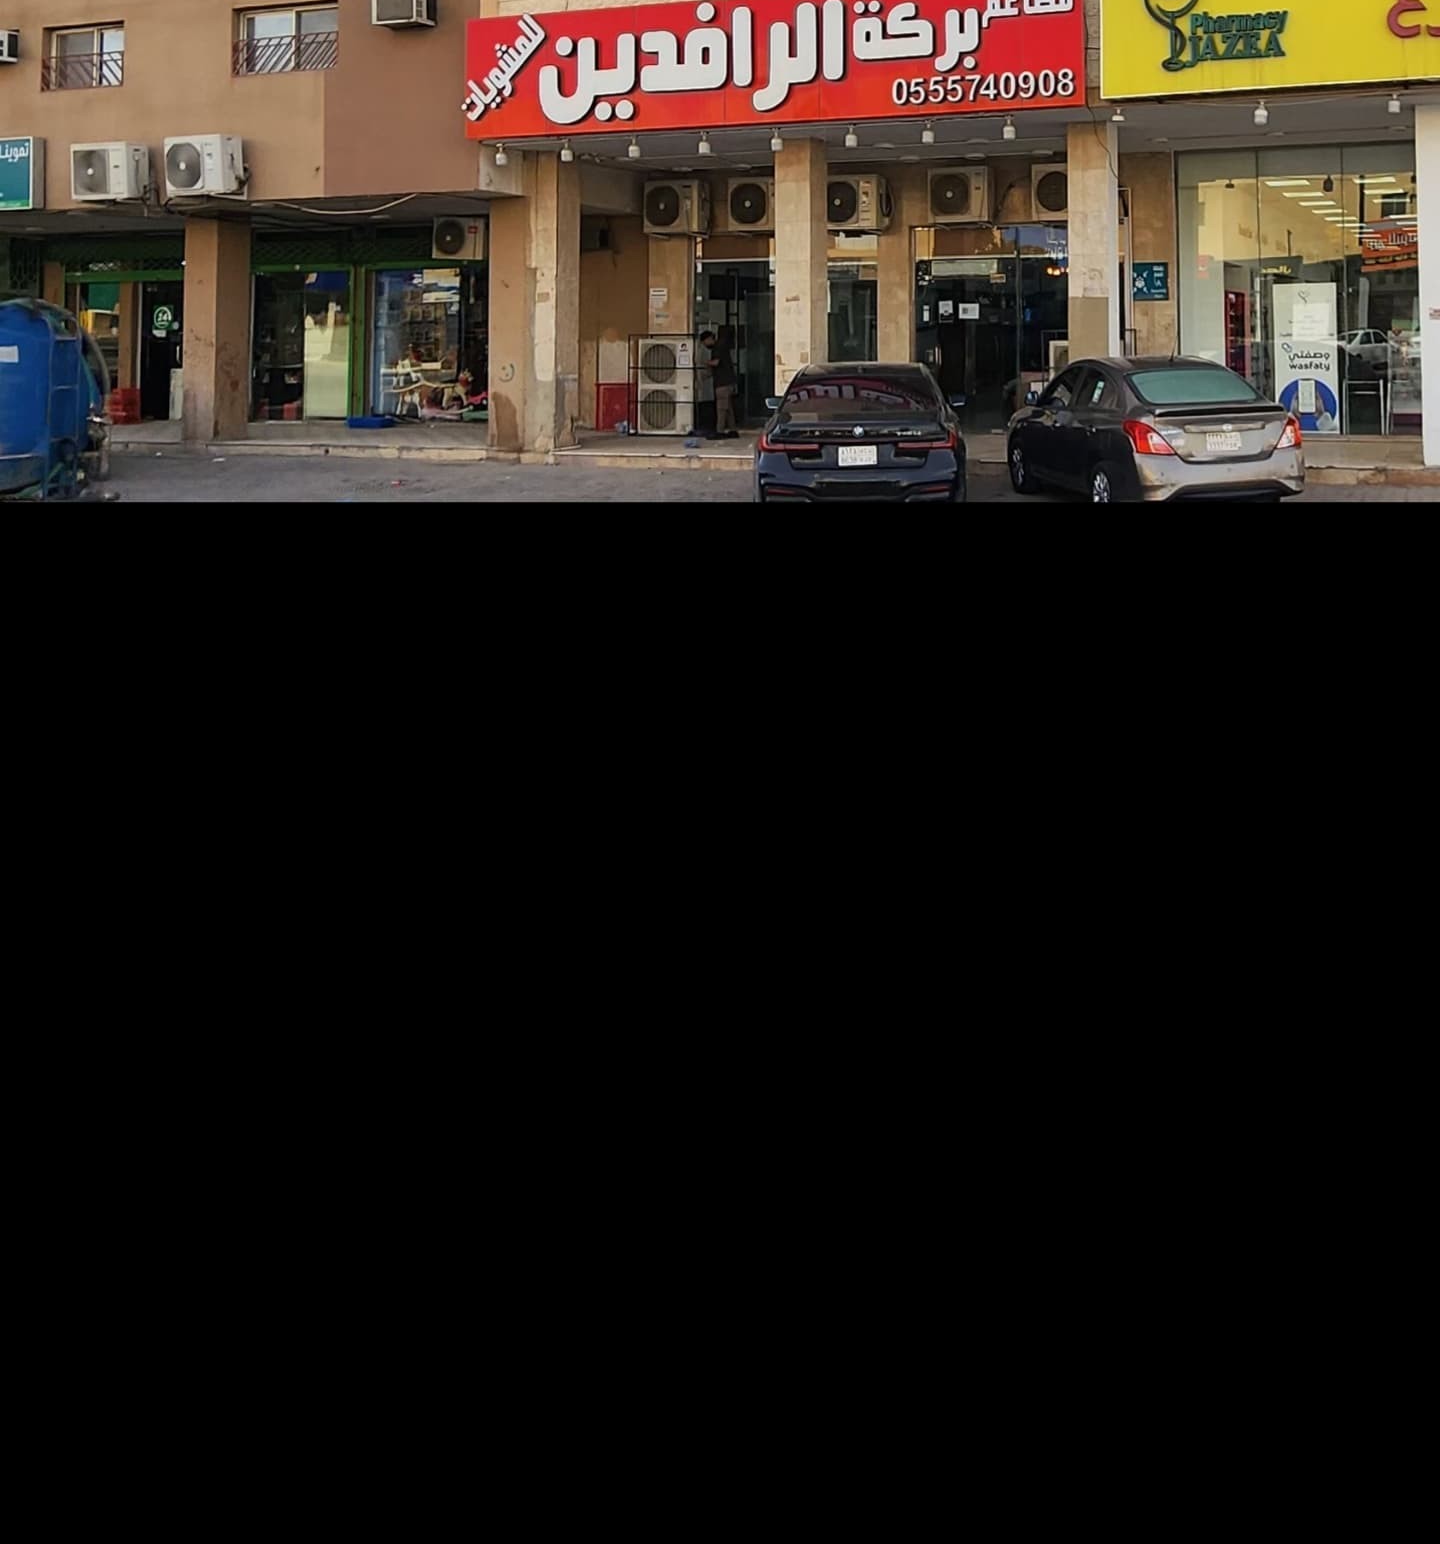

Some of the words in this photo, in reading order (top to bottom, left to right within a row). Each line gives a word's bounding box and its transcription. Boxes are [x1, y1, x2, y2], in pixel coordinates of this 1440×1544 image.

[1190, 10, 1289, 36] Pharmacy
[460, 12, 547, 122] للمشويات
[891, 68, 1075, 107] 0555740908
[1288, 361, 1331, 371] wasfaty
